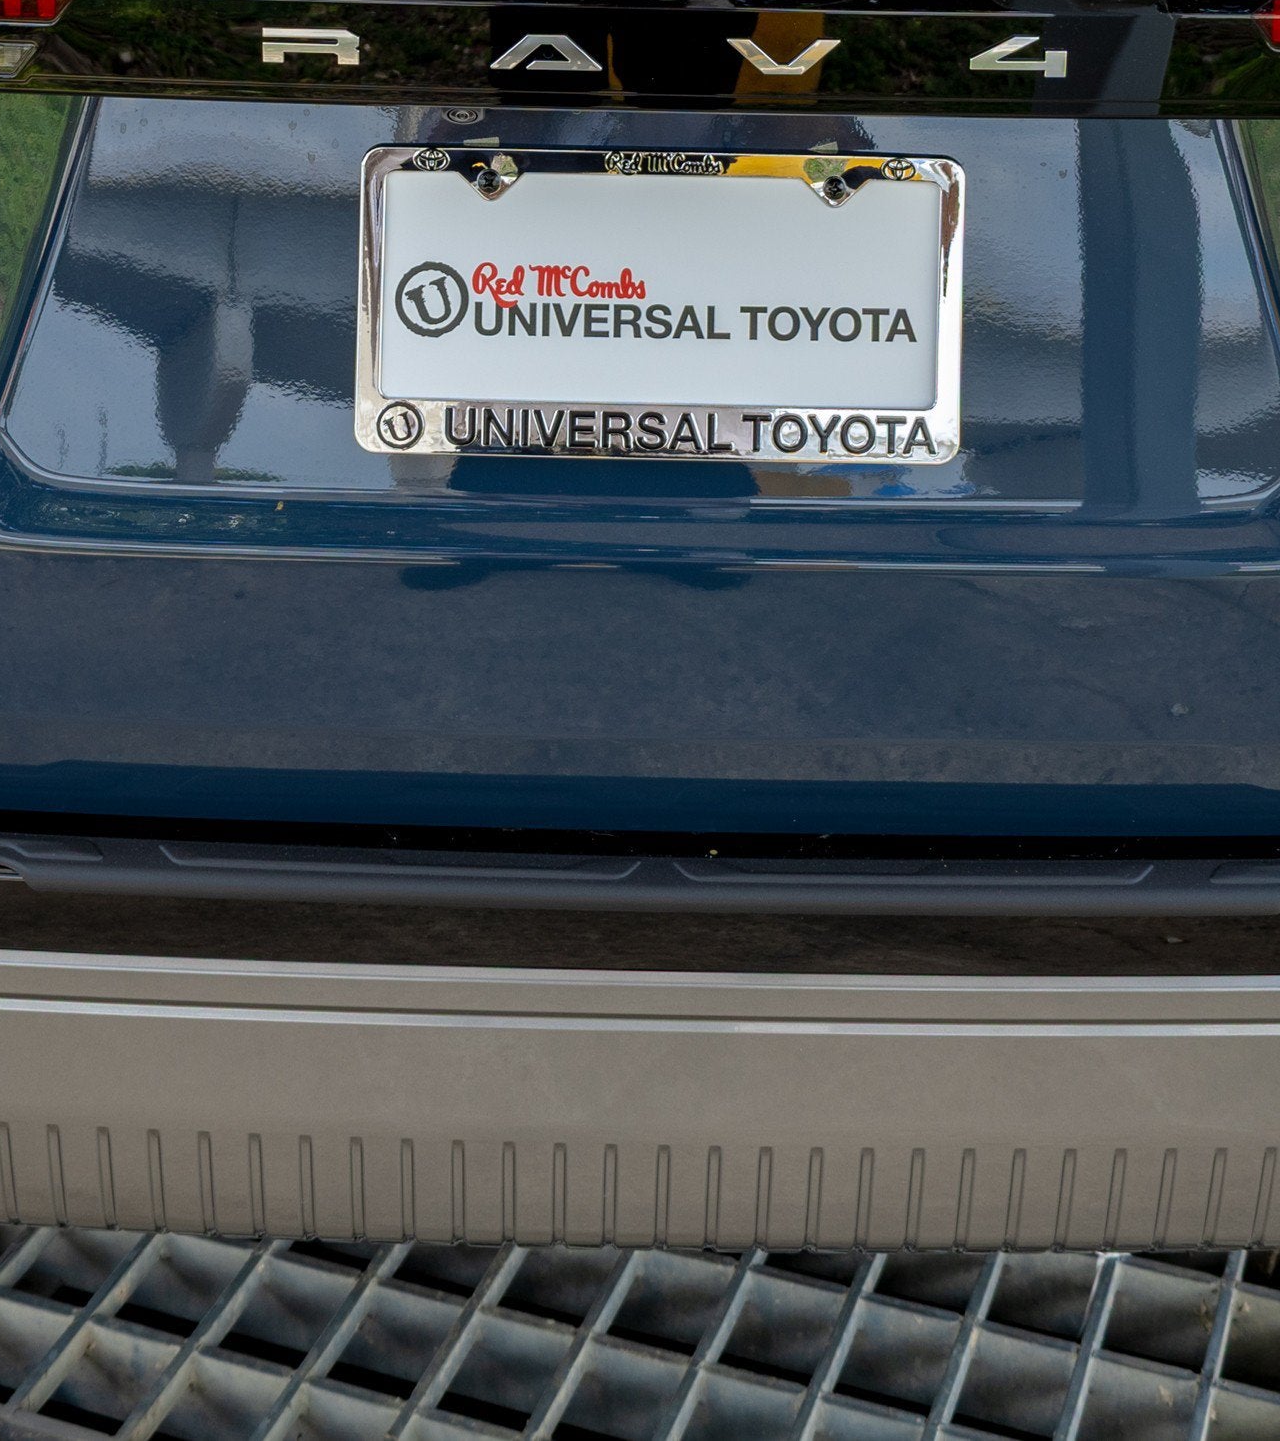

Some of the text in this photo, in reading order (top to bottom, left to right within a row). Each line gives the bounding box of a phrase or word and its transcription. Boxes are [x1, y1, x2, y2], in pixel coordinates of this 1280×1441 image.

[261, 26, 1068, 79] RAV4
[605, 150, 727, 176] Red McCombs
[472, 261, 646, 308] Red McCombs
[474, 301, 918, 343] UNIVERSAL TOYOTA
[444, 406, 939, 456] UNIVERSAL TOYOTA
